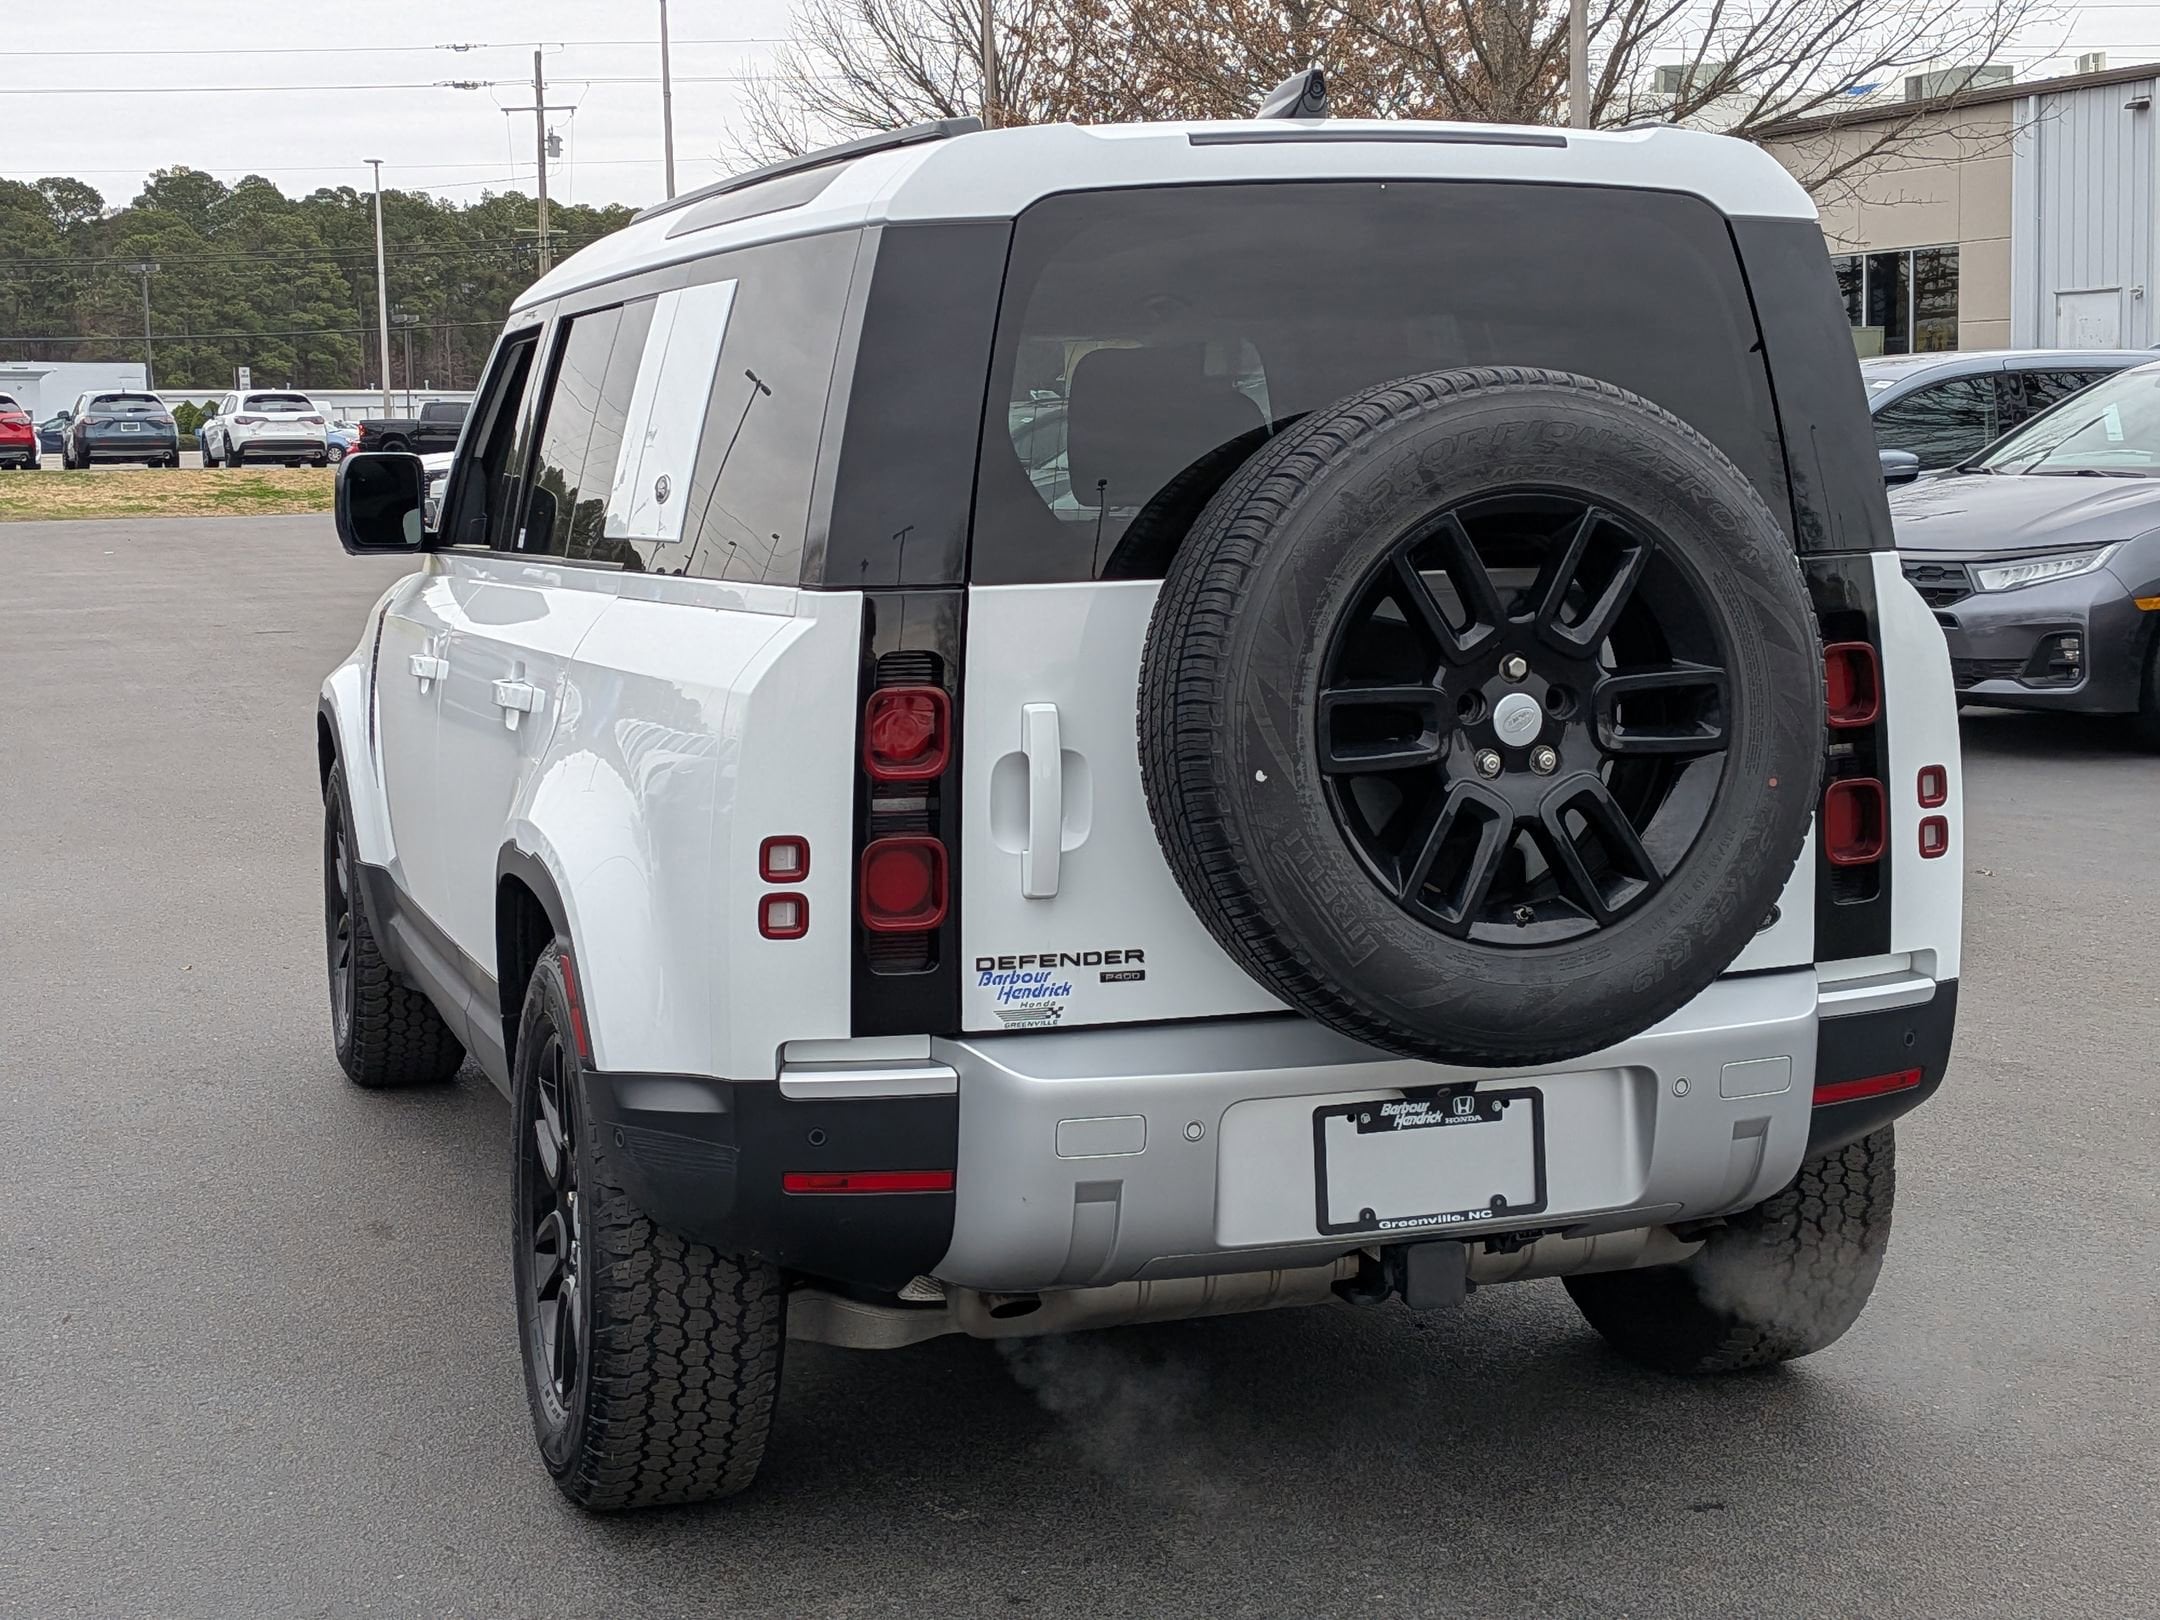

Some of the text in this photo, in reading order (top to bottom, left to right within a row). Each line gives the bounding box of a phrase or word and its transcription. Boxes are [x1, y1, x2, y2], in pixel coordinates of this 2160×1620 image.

[976, 949, 1145, 972] DEFENDER
[978, 971, 1051, 987] Barbour
[997, 982, 1073, 1004] Hendrick
[1004, 1020, 1058, 1029] GREENVILLE
[1380, 1102, 1431, 1118] Barbour
[1394, 1110, 1443, 1130] Hendrick
[1445, 1115, 1483, 1124] HONDA
[1468, 1210, 1494, 1221] NC
